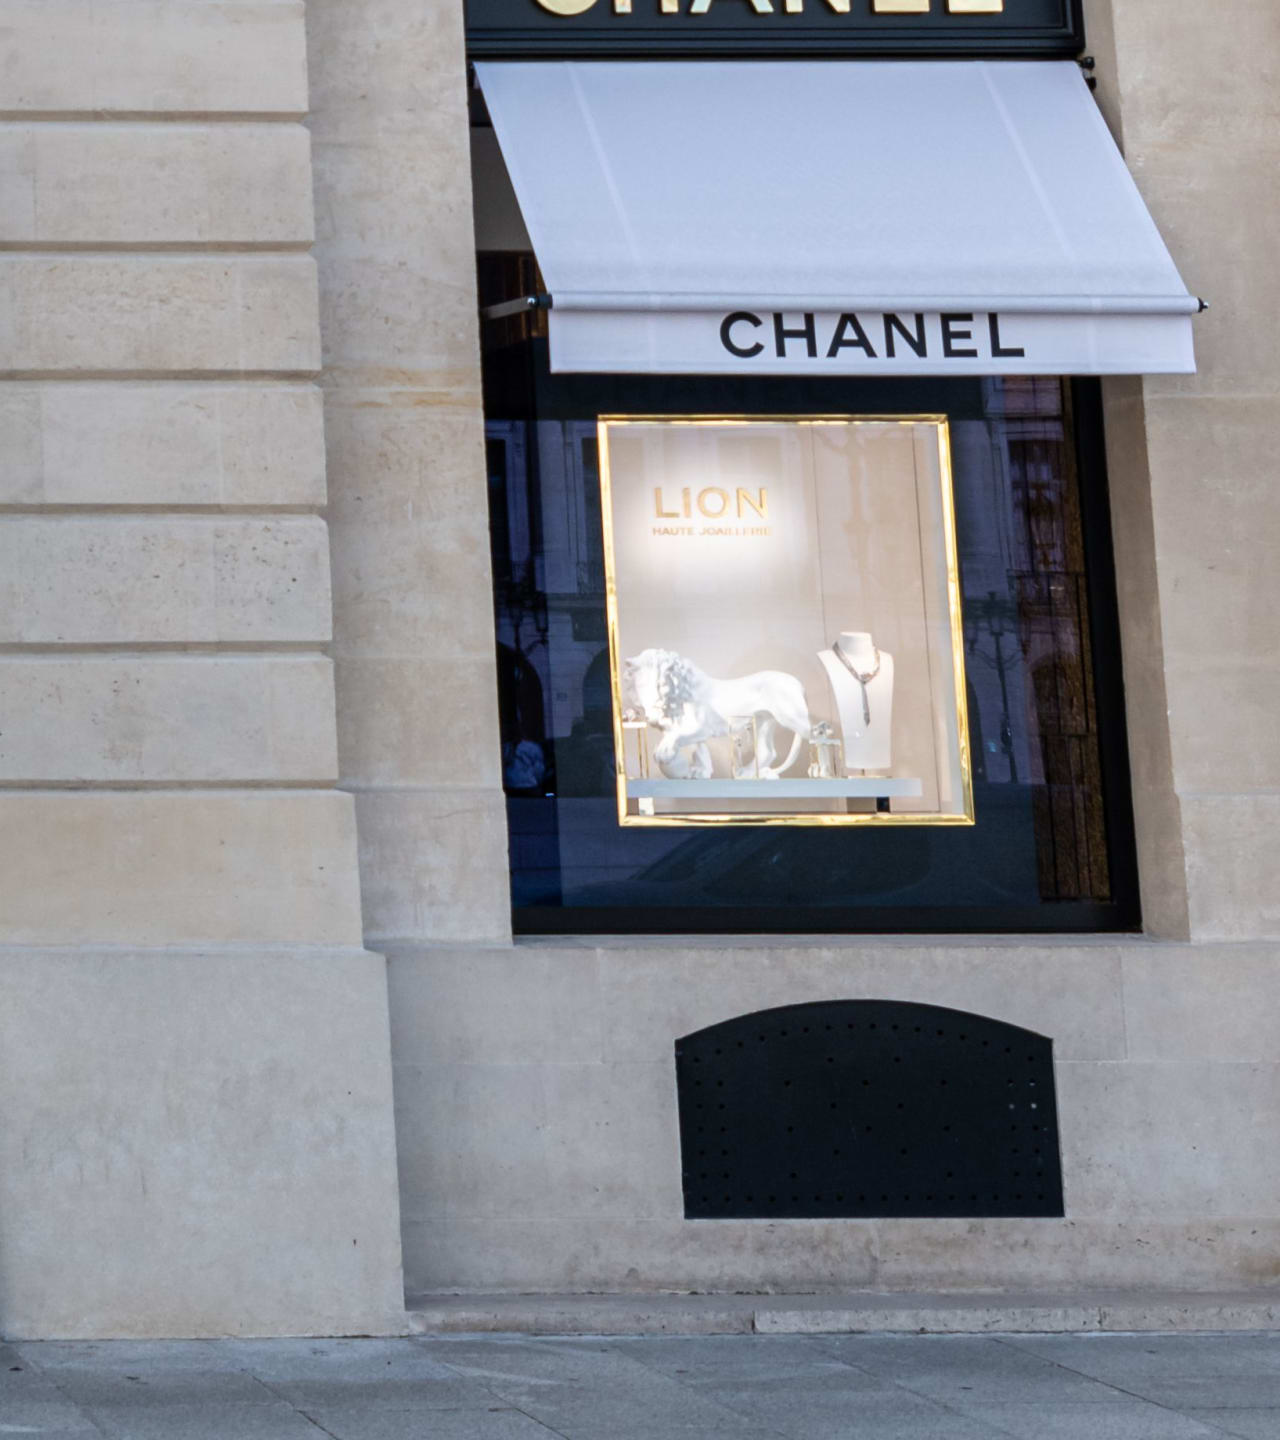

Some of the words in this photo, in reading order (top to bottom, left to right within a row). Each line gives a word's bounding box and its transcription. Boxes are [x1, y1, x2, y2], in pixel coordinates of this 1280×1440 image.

[719, 311, 1026, 359] CHANEL
[653, 486, 768, 519] LION
[652, 526, 694, 537] HAUTE
